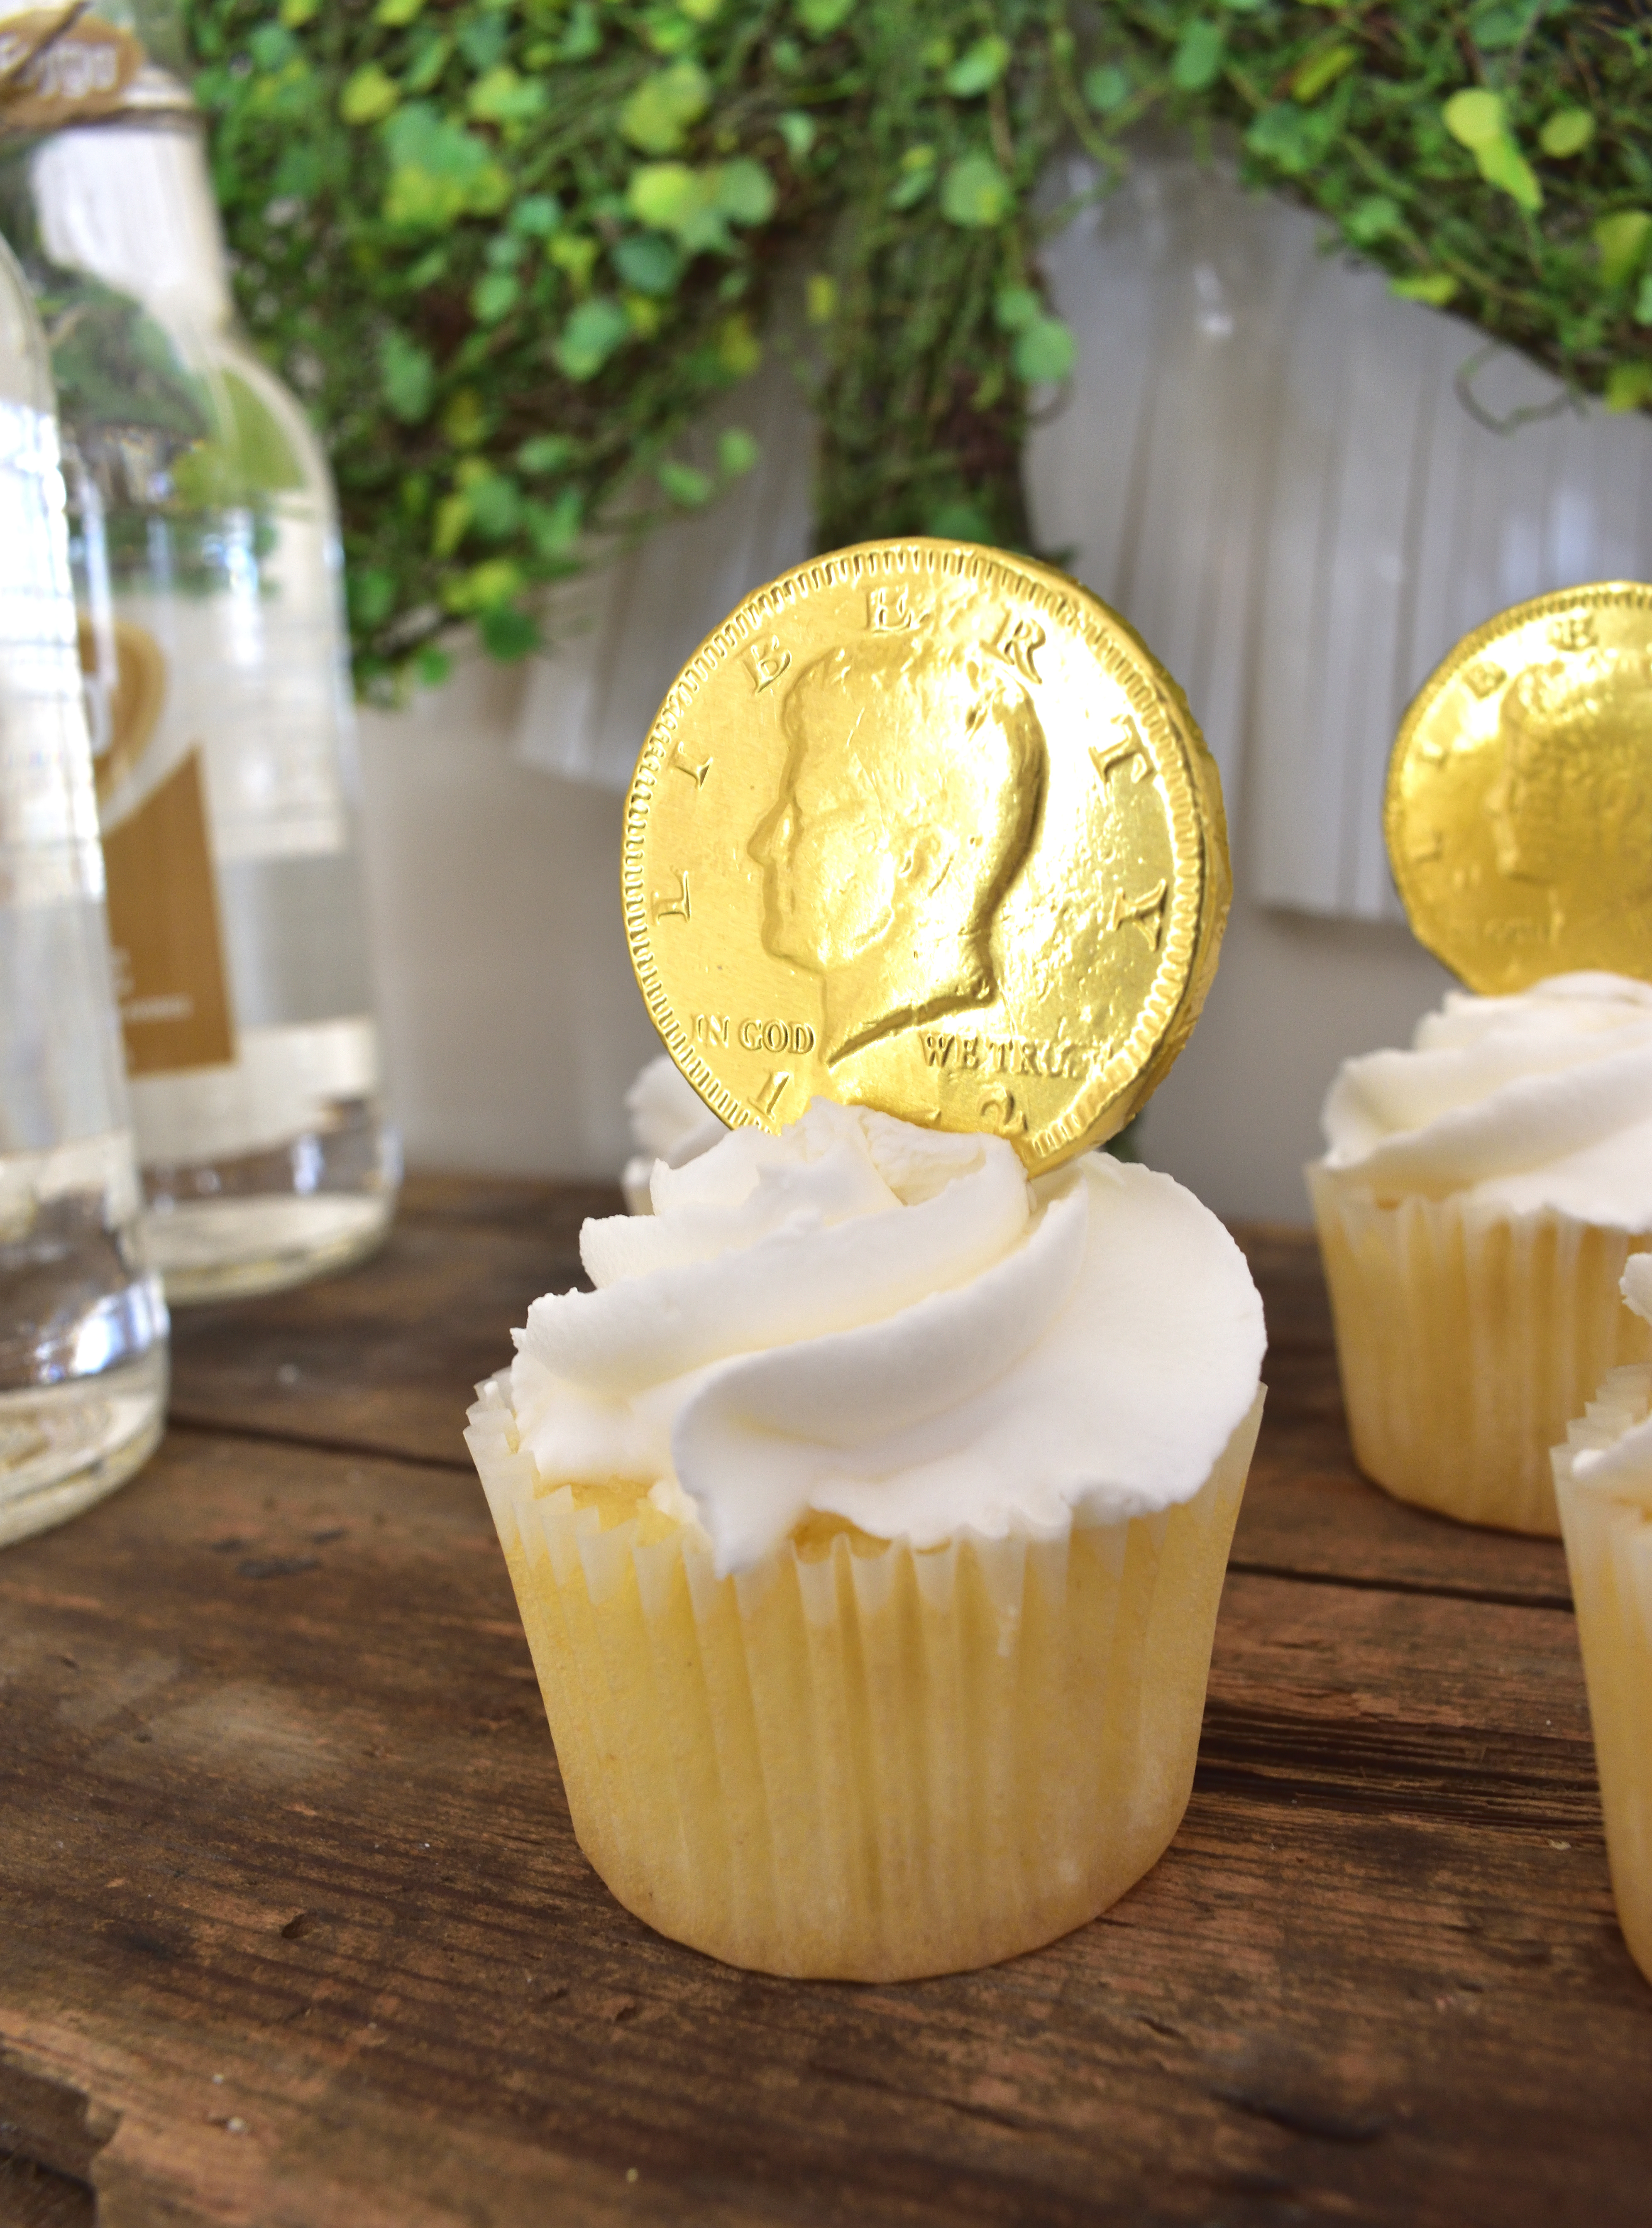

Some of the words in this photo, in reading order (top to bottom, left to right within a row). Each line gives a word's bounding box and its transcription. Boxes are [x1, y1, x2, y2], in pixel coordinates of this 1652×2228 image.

[651, 583, 1168, 951] LIBERTY
[691, 1014, 731, 1049] IN
[738, 1018, 816, 1055] GOD
[916, 1030, 980, 1070] WE
